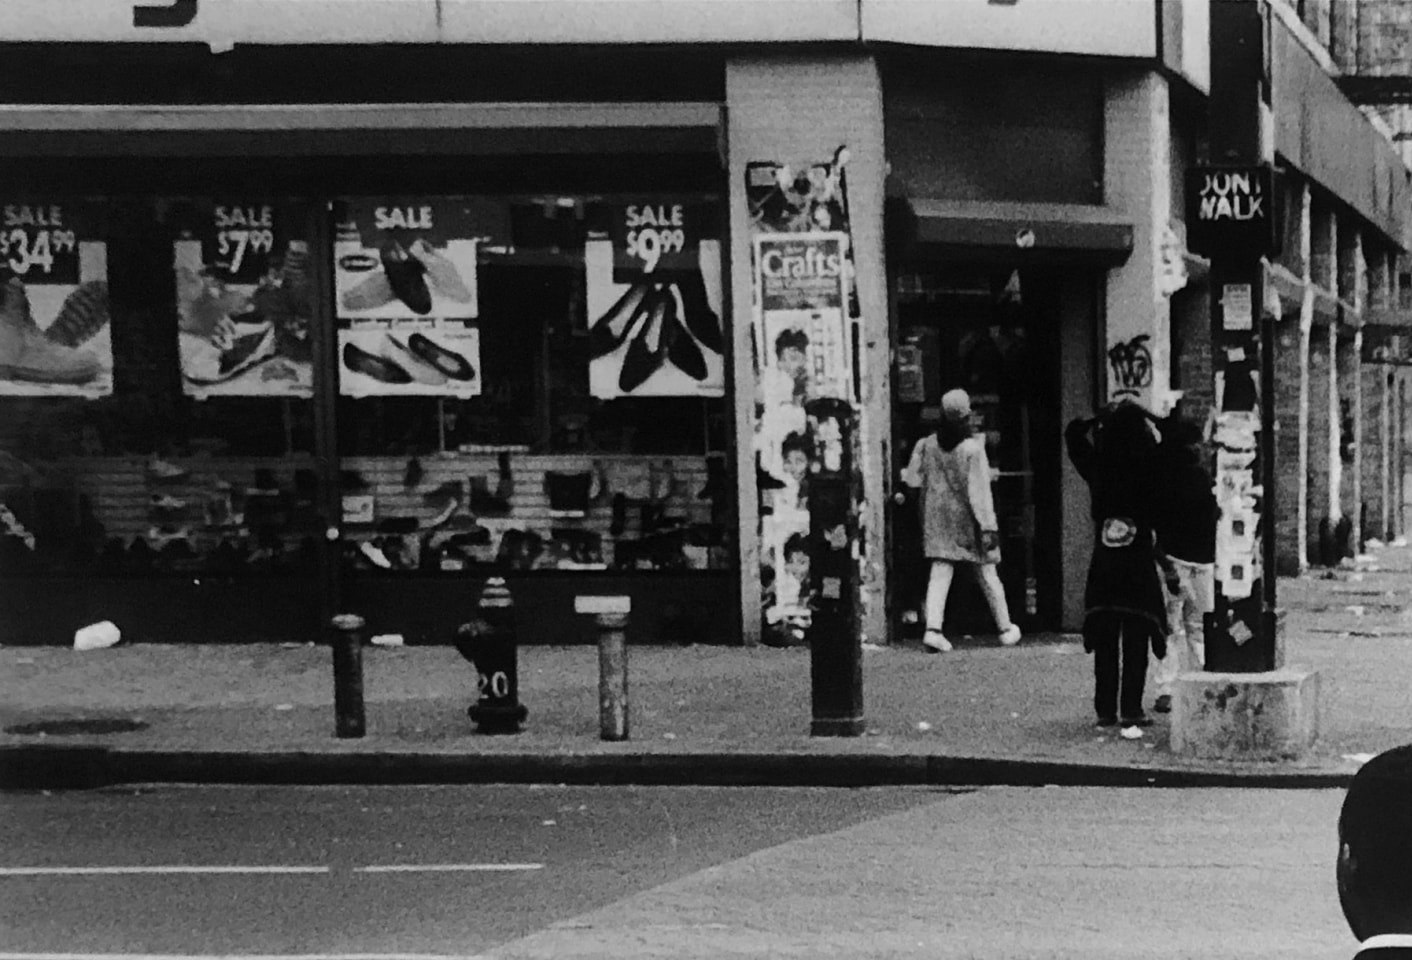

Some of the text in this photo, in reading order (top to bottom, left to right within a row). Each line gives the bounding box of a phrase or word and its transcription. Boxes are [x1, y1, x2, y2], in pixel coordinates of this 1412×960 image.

[4, 205, 62, 226] SALE
[215, 205, 273, 227] SALE
[374, 206, 433, 230] SALE
[626, 204, 684, 226] SALE
[1199, 195, 1264, 221] WALK
[762, 247, 841, 278] Crafts
